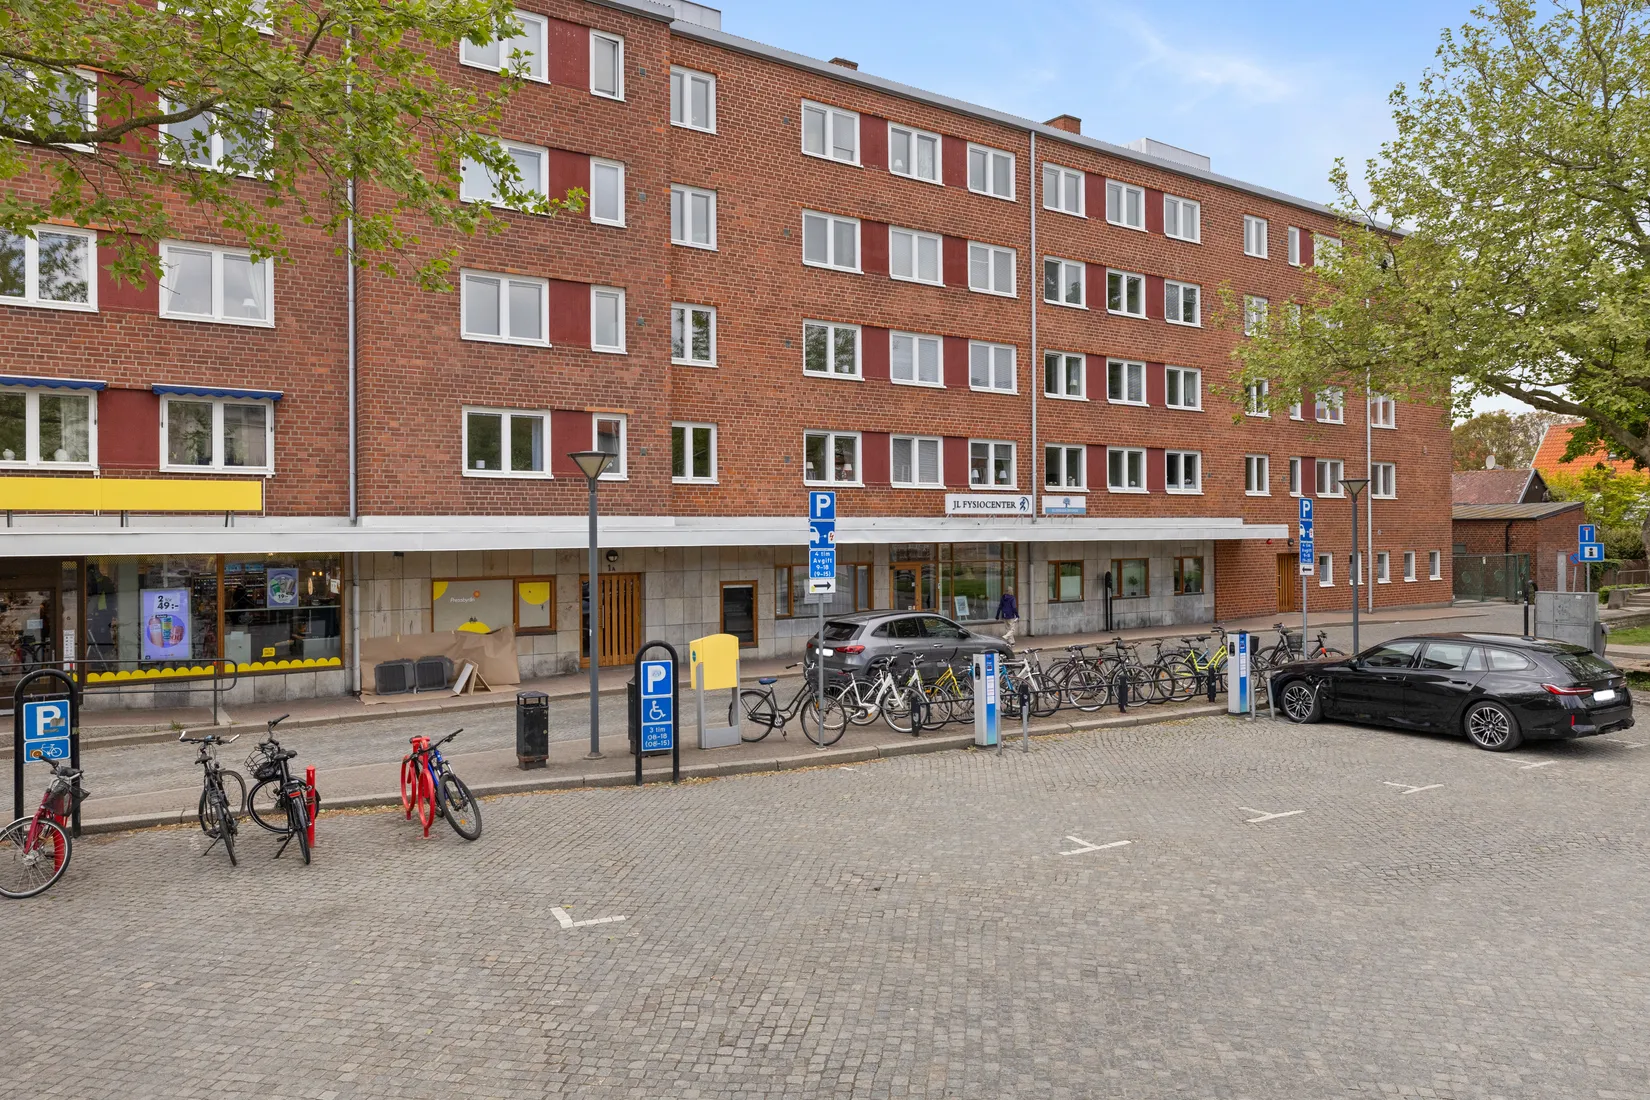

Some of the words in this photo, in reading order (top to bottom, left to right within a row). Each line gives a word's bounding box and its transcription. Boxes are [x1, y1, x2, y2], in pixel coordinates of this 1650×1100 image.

[816, 494, 831, 517] P
[952, 500, 961, 510] JL
[962, 500, 1016, 509] FYSIOCENTER
[1302, 500, 1311, 517] P
[157, 601, 179, 610] 49:-
[647, 665, 667, 693] P
[36, 705, 62, 736] P
